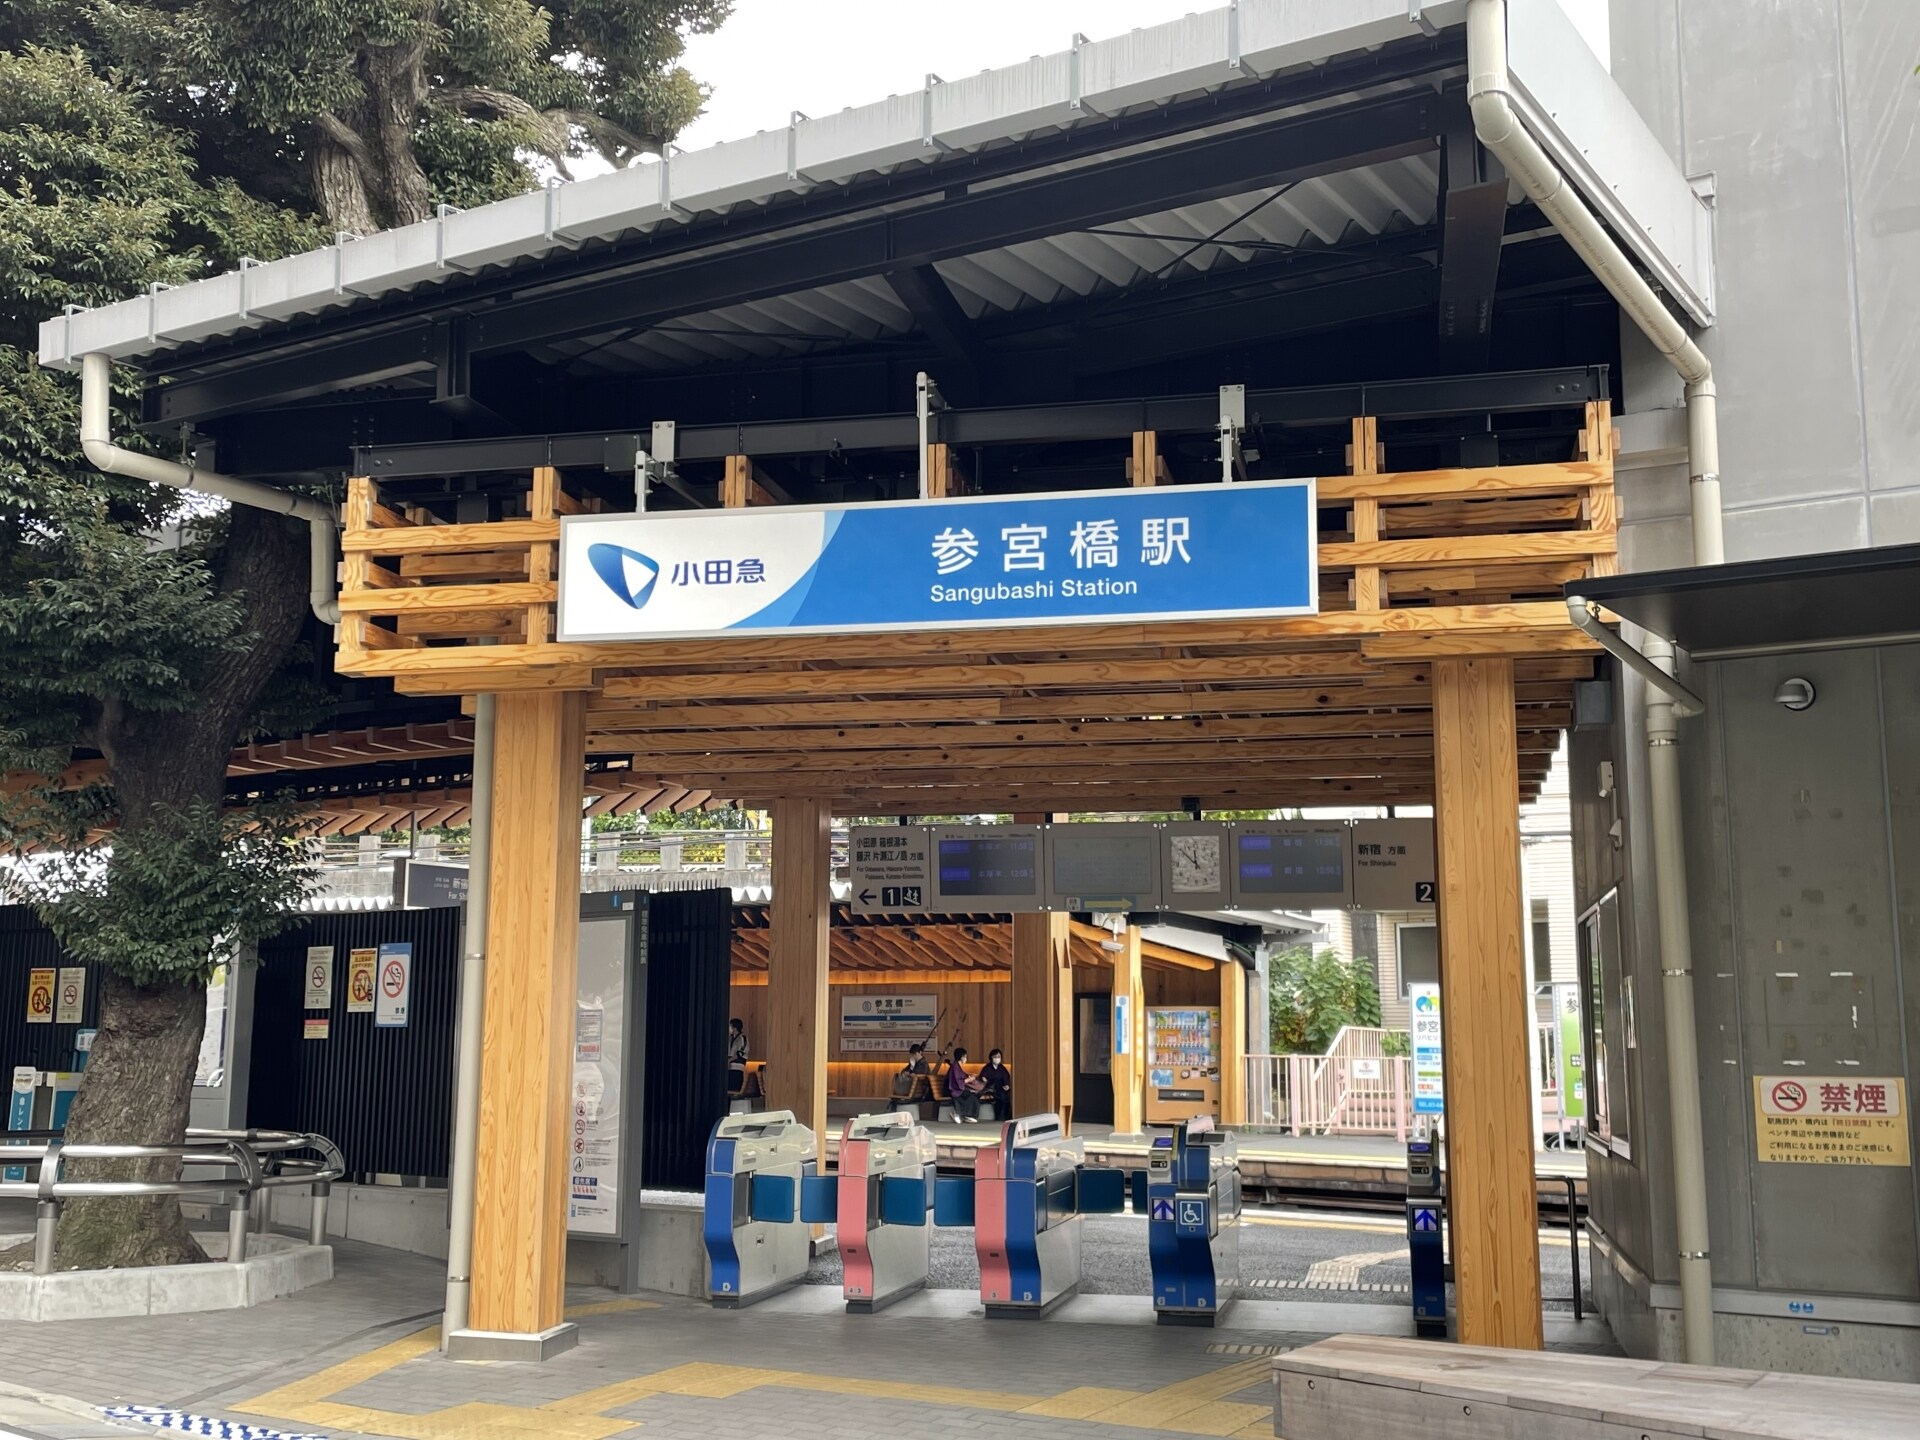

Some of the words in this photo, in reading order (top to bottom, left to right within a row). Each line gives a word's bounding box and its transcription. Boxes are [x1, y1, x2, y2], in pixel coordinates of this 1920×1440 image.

[930, 516, 1192, 576] 参宮橋駅
[671, 558, 766, 586] 小田急
[930, 580, 1054, 605] Sangubashi
[1061, 577, 1138, 598] Station
[856, 836, 877, 848] 小田原
[1358, 844, 1381, 855] 新宿
[1388, 846, 1406, 855] 方面
[887, 888, 894, 905] 1
[1420, 884, 1432, 902] 2
[875, 998, 903, 1007] 参宮橋
[1819, 1083, 1887, 1113] 禁煙
